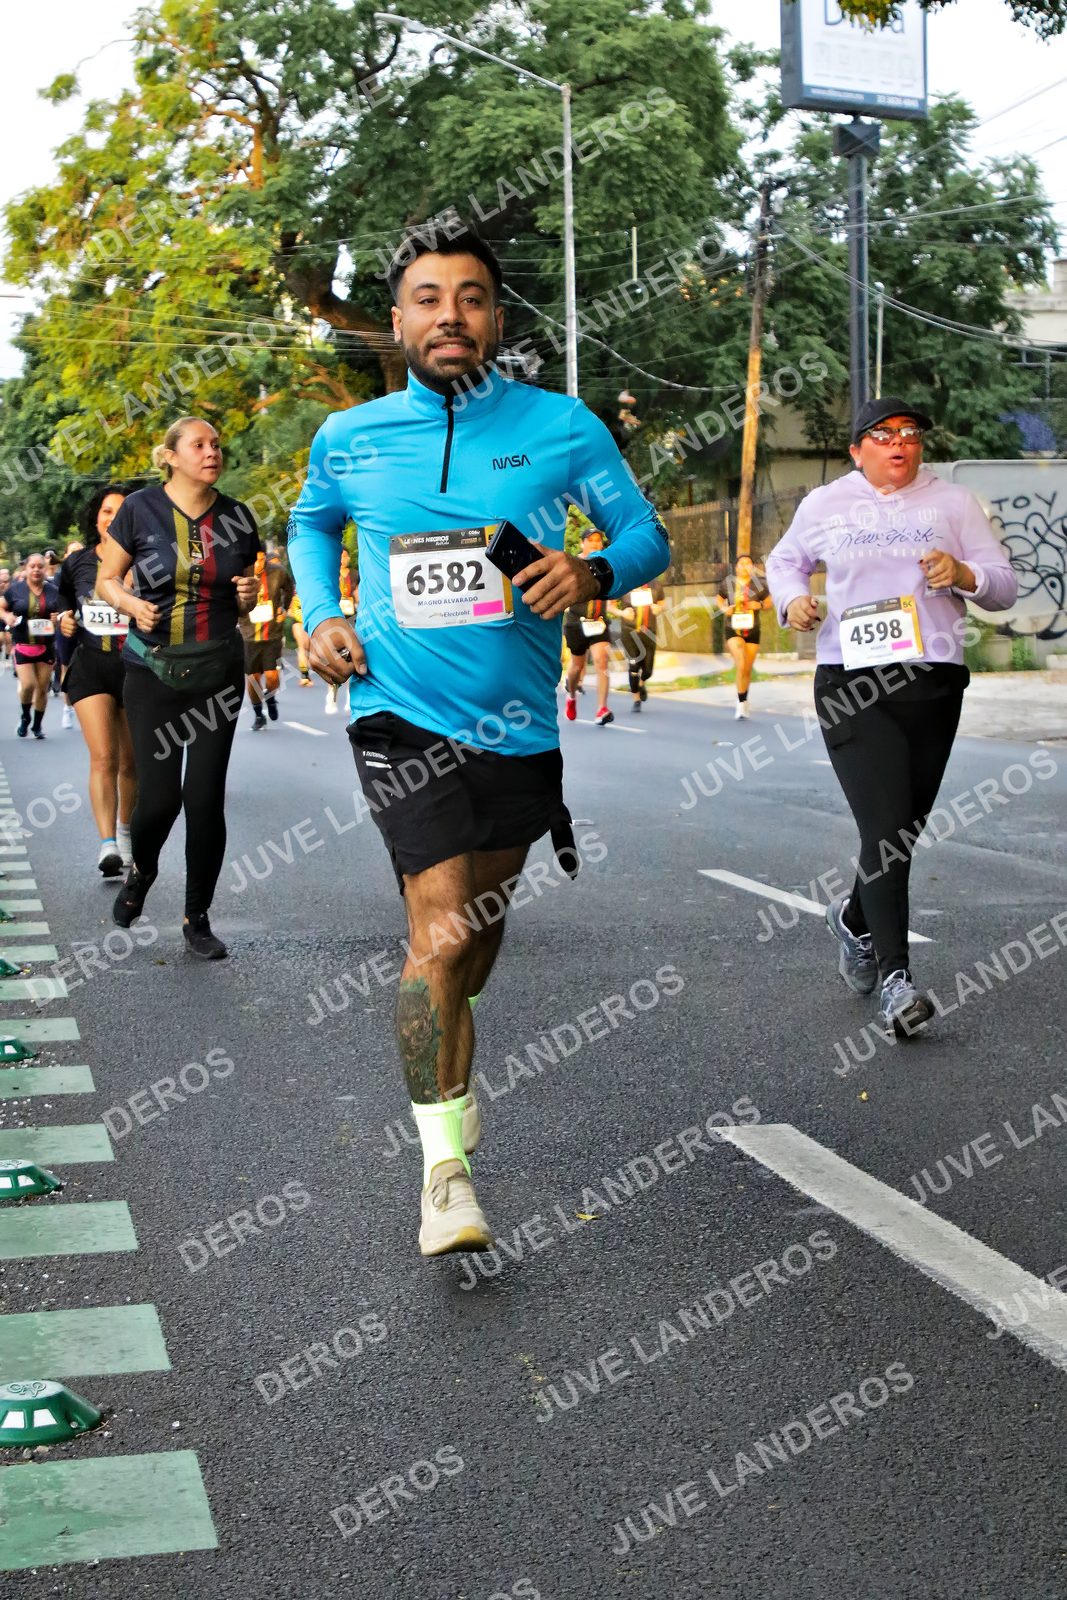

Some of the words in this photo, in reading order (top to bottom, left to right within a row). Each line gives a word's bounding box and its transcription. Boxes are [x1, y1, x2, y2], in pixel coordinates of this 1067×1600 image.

[492, 454, 531, 470] NASA
[406, 560, 485, 596] 6582
[443, 596, 478, 604] ALVARADO
[902, 600, 912, 608] 5K
[89, 611, 120, 624] 2513
[850, 619, 902, 645] 4598
